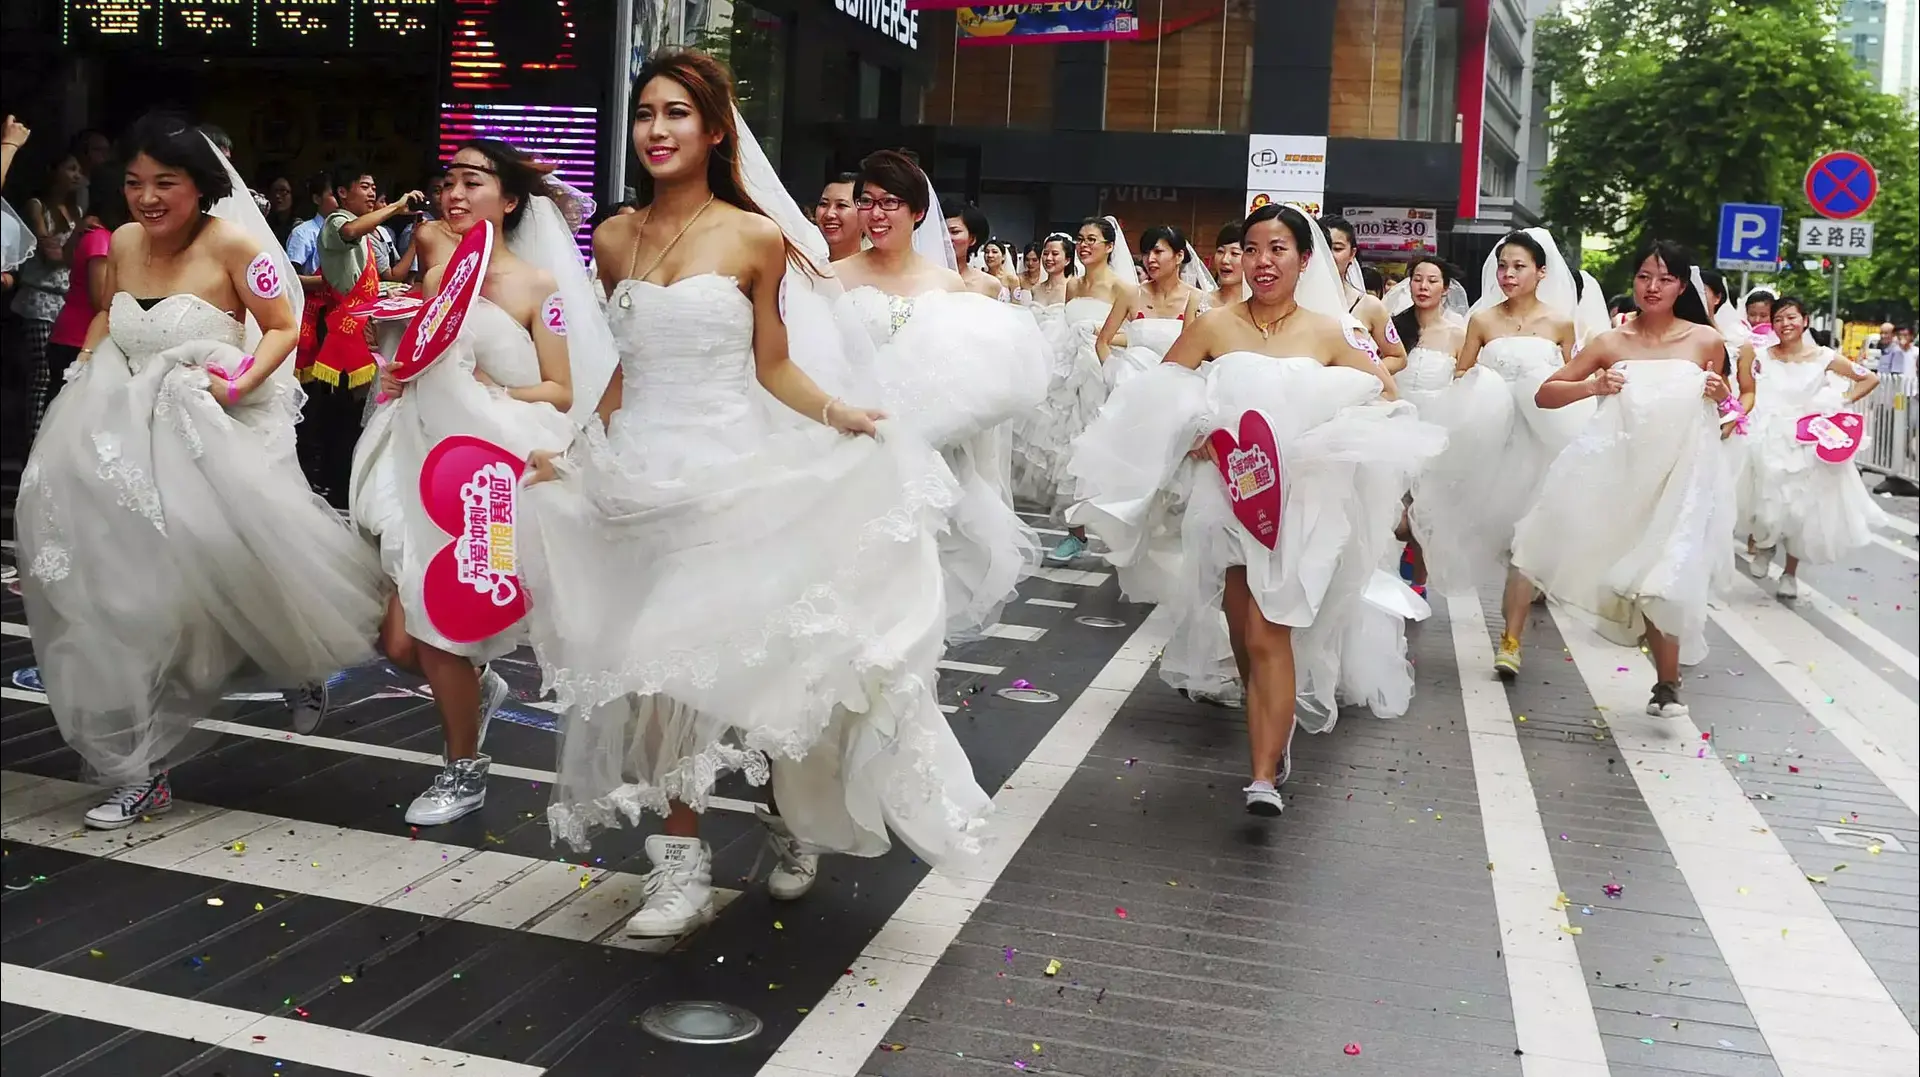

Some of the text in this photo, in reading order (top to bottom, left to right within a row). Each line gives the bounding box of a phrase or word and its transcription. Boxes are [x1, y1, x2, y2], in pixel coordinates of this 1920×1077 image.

[1731, 213, 1767, 252] P
[1806, 226, 1867, 248] 全路段
[256, 265, 279, 292] 62
[489, 474, 513, 571] 新娘赛跑
[469, 506, 488, 581] 为爱冲刺
